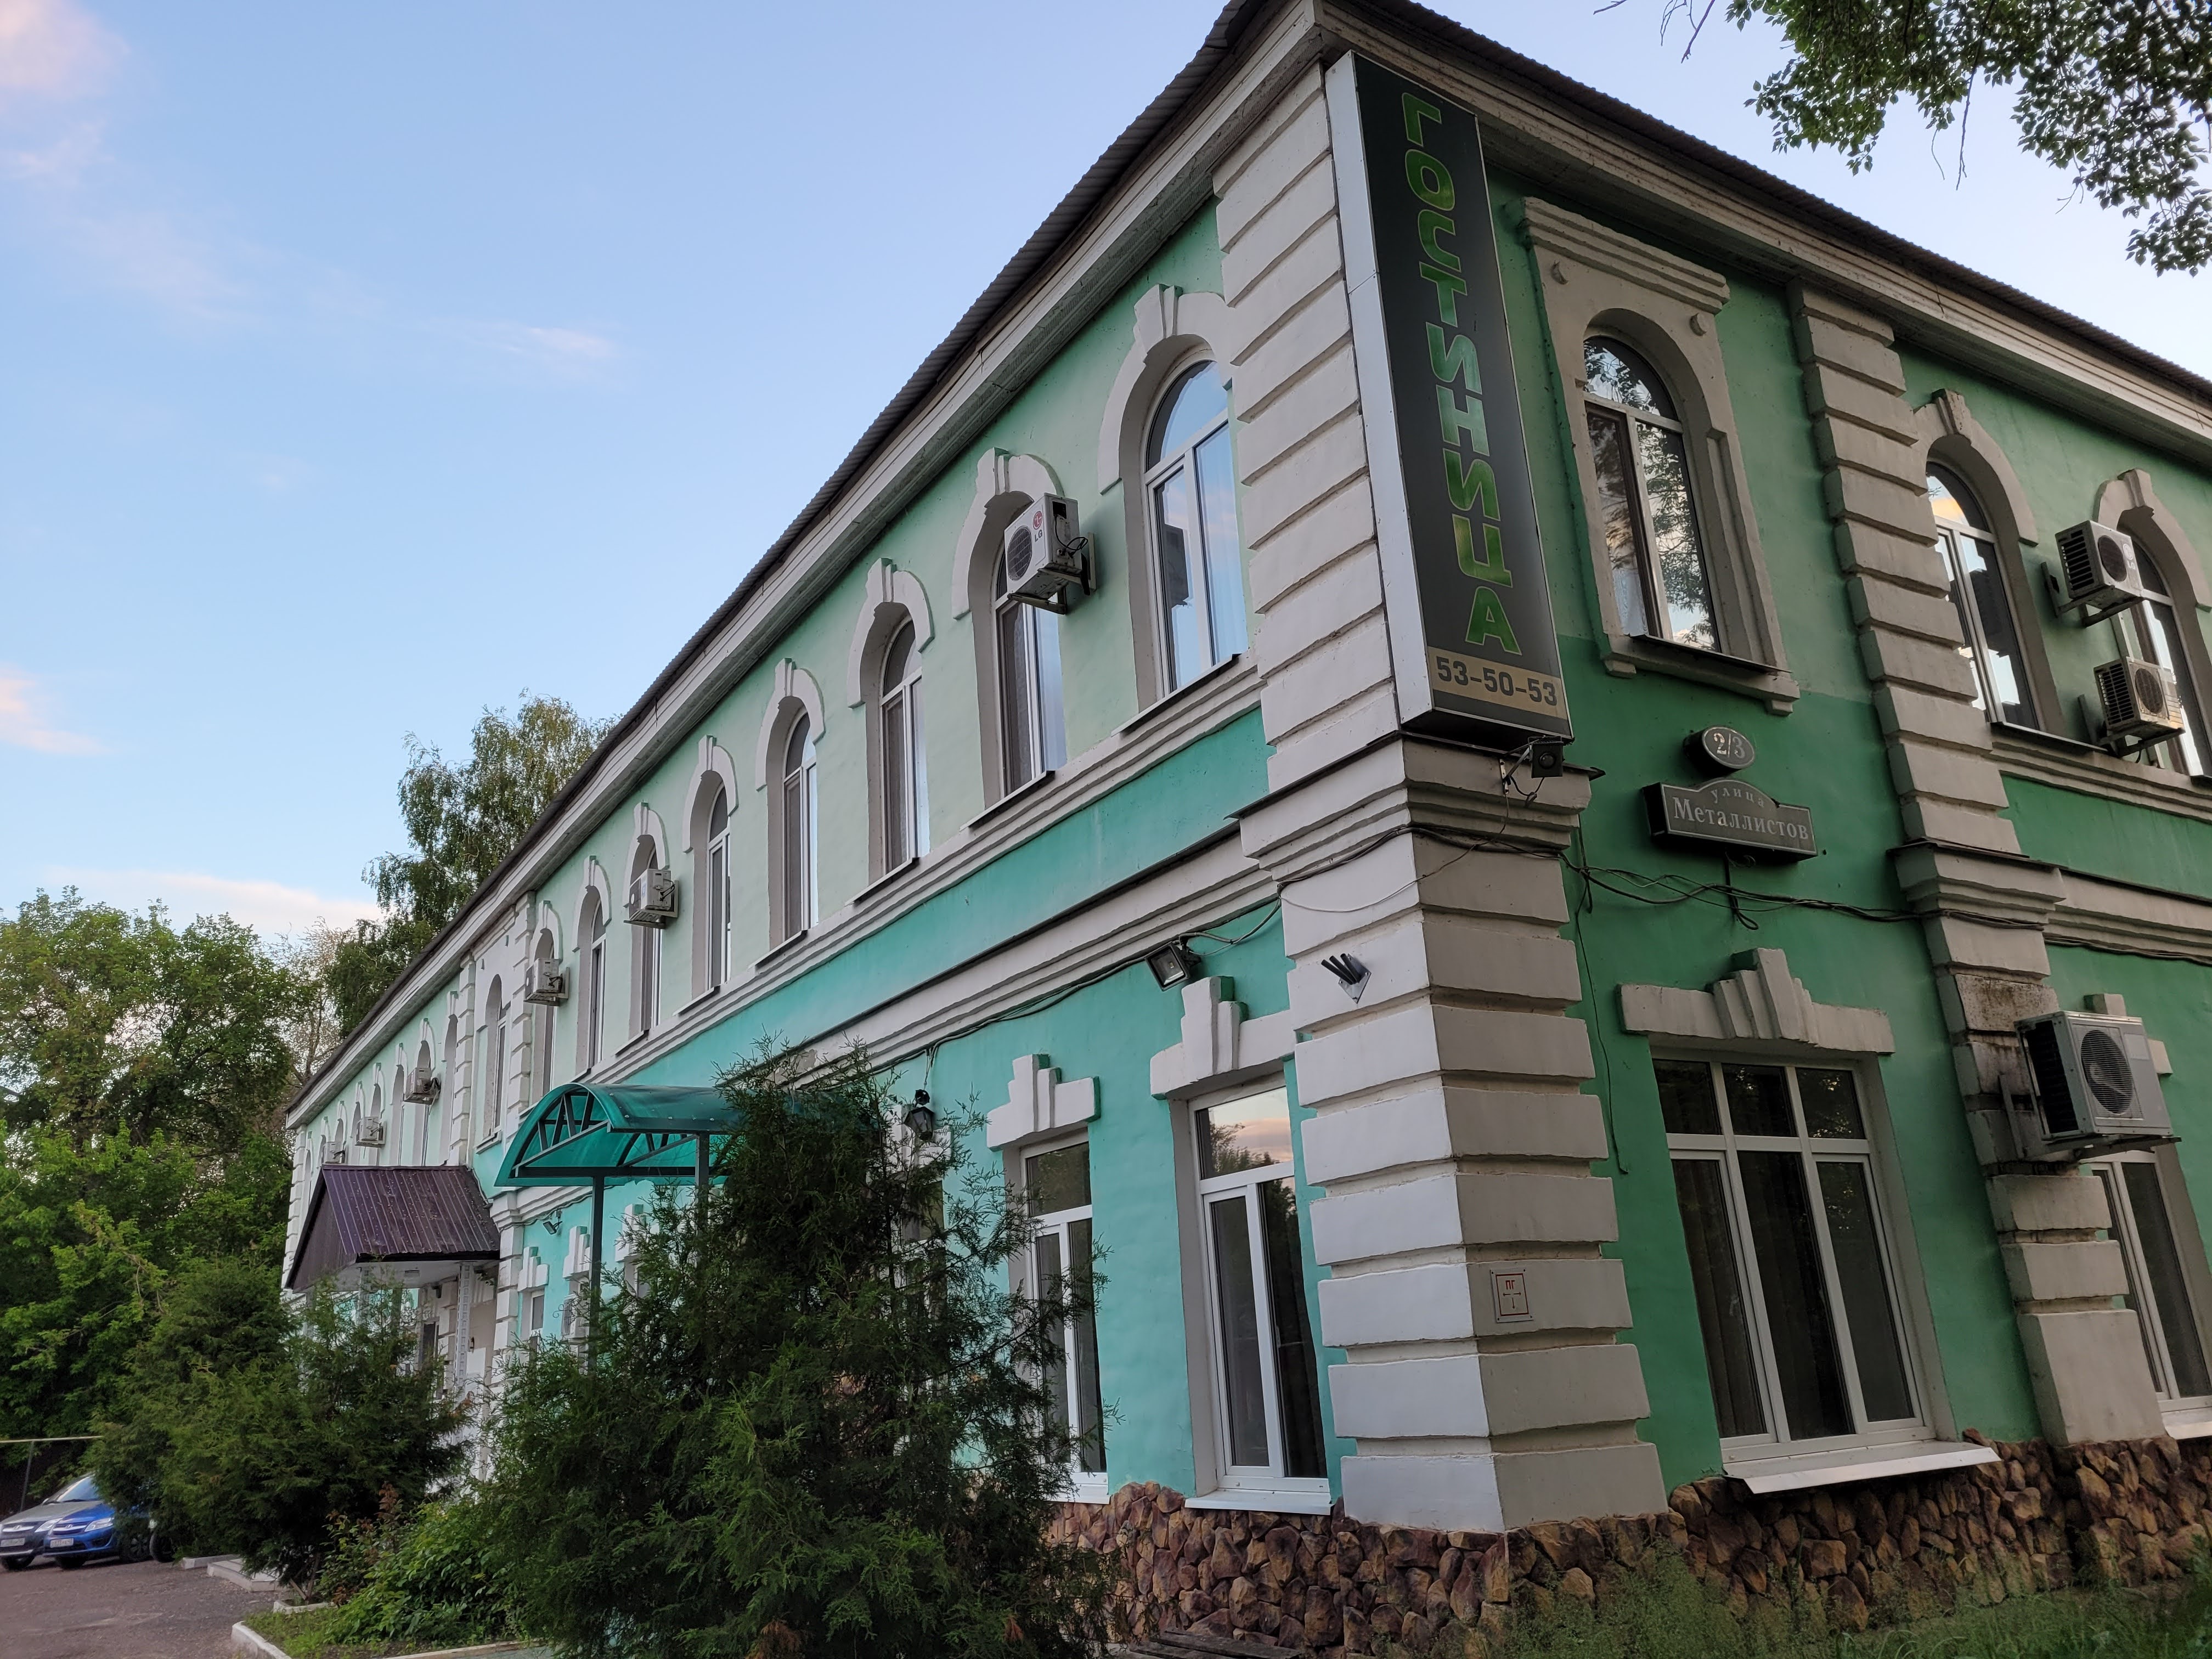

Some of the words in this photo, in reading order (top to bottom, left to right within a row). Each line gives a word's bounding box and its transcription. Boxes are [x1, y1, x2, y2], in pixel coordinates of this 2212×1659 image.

[1401, 92, 1522, 656] ГОСТИНИЦА
[1035, 529, 1043, 543] LG
[2127, 560, 2136, 570] LG
[1436, 656, 1558, 706] 53-50-53
[1713, 732, 1746, 759] 2/3
[1711, 787, 1765, 808] улица
[1672, 797, 1809, 840] Металлистов
[1505, 1279, 1515, 1290] ПГ
